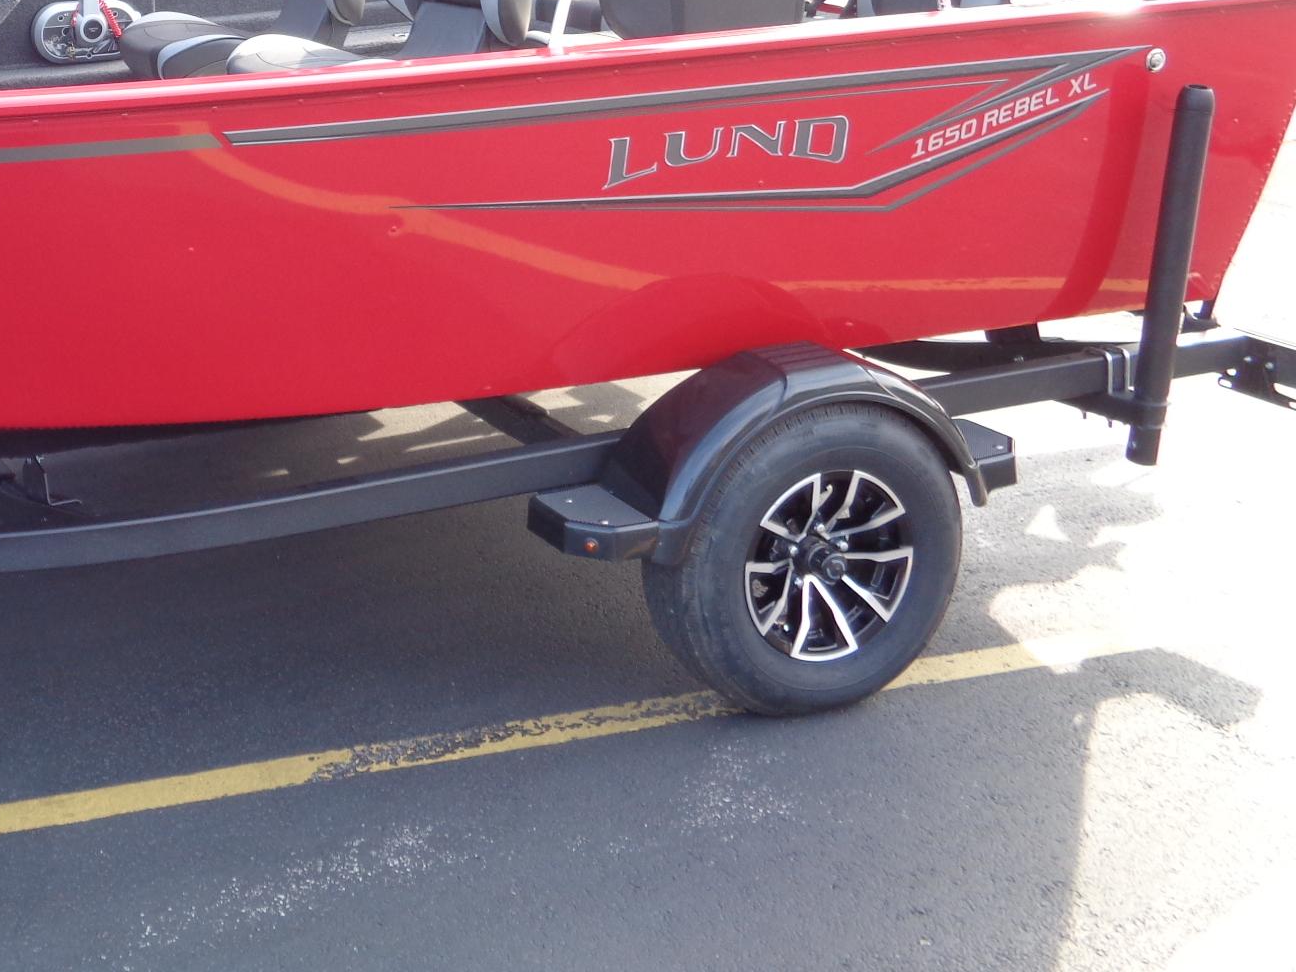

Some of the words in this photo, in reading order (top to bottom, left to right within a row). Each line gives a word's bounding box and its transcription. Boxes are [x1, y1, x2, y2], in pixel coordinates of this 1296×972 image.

[602, 115, 849, 190] LUND
[911, 118, 978, 158] 1650
[981, 88, 1060, 136] REBEL
[1068, 72, 1097, 98] XL
